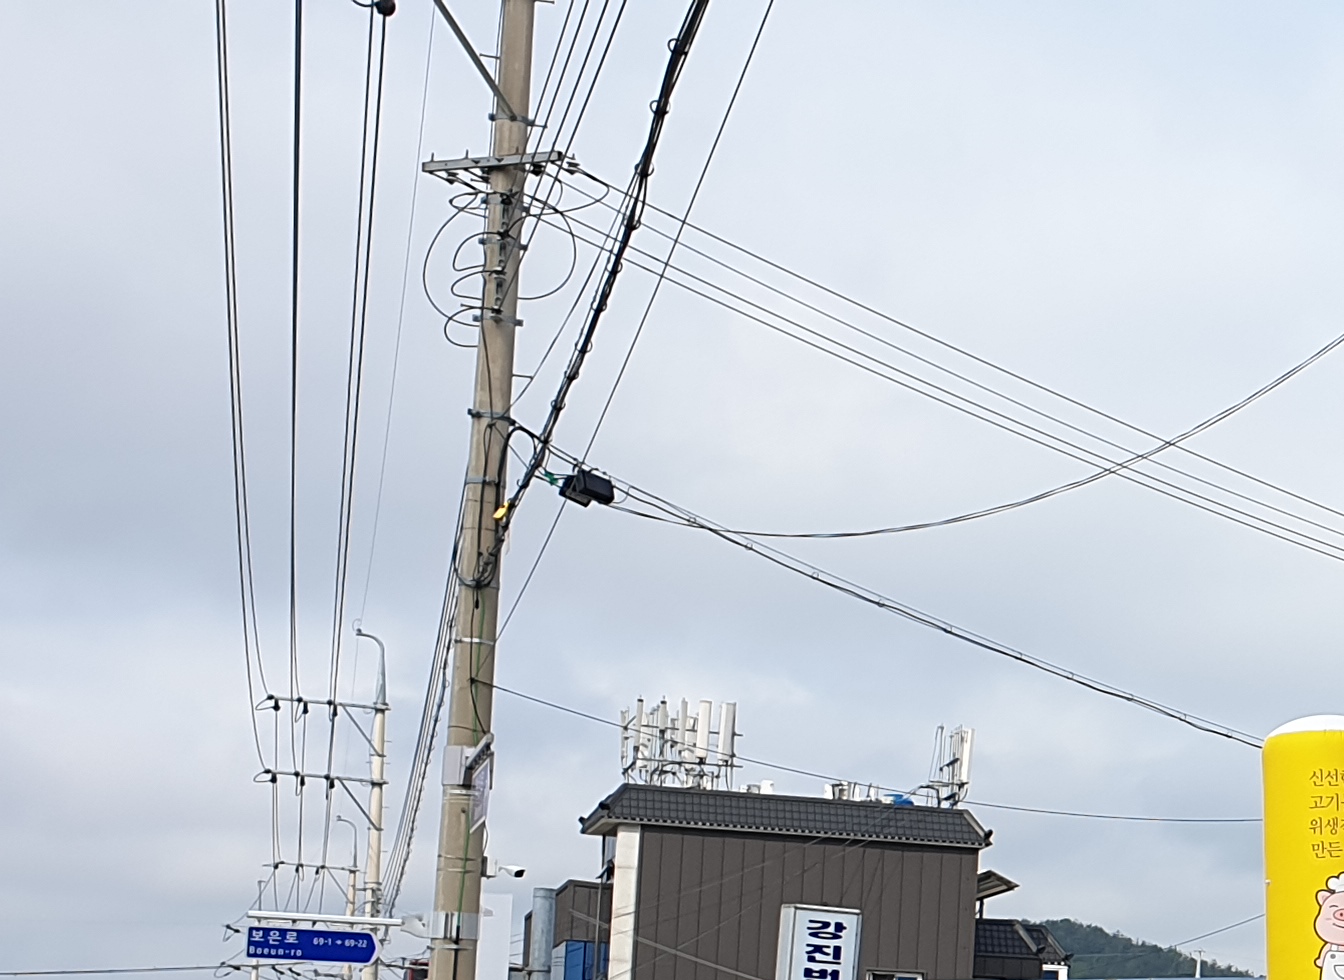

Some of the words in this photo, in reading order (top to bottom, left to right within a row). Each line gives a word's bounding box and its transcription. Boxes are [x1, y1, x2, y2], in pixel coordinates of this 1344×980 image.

[1311, 841, 1343, 859] 만든
[250, 929, 299, 945] 보은로
[249, 945, 302, 957] Boeun-ro
